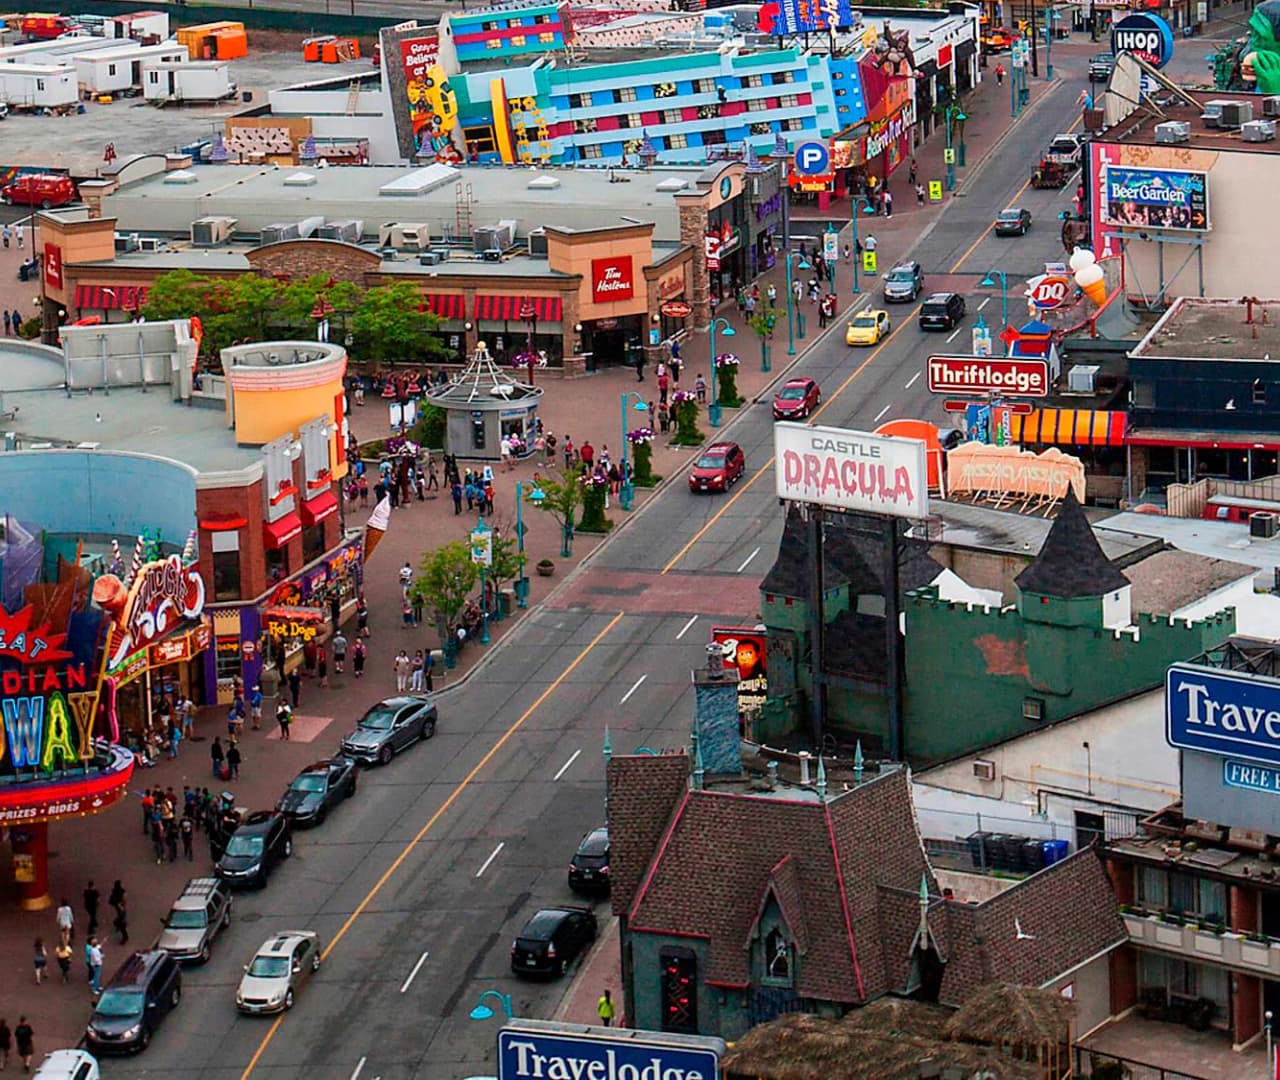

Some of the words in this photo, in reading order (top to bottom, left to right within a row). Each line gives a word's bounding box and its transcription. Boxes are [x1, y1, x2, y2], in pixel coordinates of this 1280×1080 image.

[1117, 32, 1159, 55] IHOP
[803, 149, 822, 169] P
[604, 267, 622, 279] Tim
[597, 279, 631, 293] Hortons
[1038, 282, 1065, 301] DQ
[931, 363, 1042, 392] Thriftlodge
[811, 437, 881, 458] CASTLE
[784, 449, 914, 506] DRACULA
[268, 621, 287, 635] Hot
[290, 622, 317, 641] Dogs
[1231, 765, 1270, 788] FREE
[48, 802, 80, 815] RIDES
